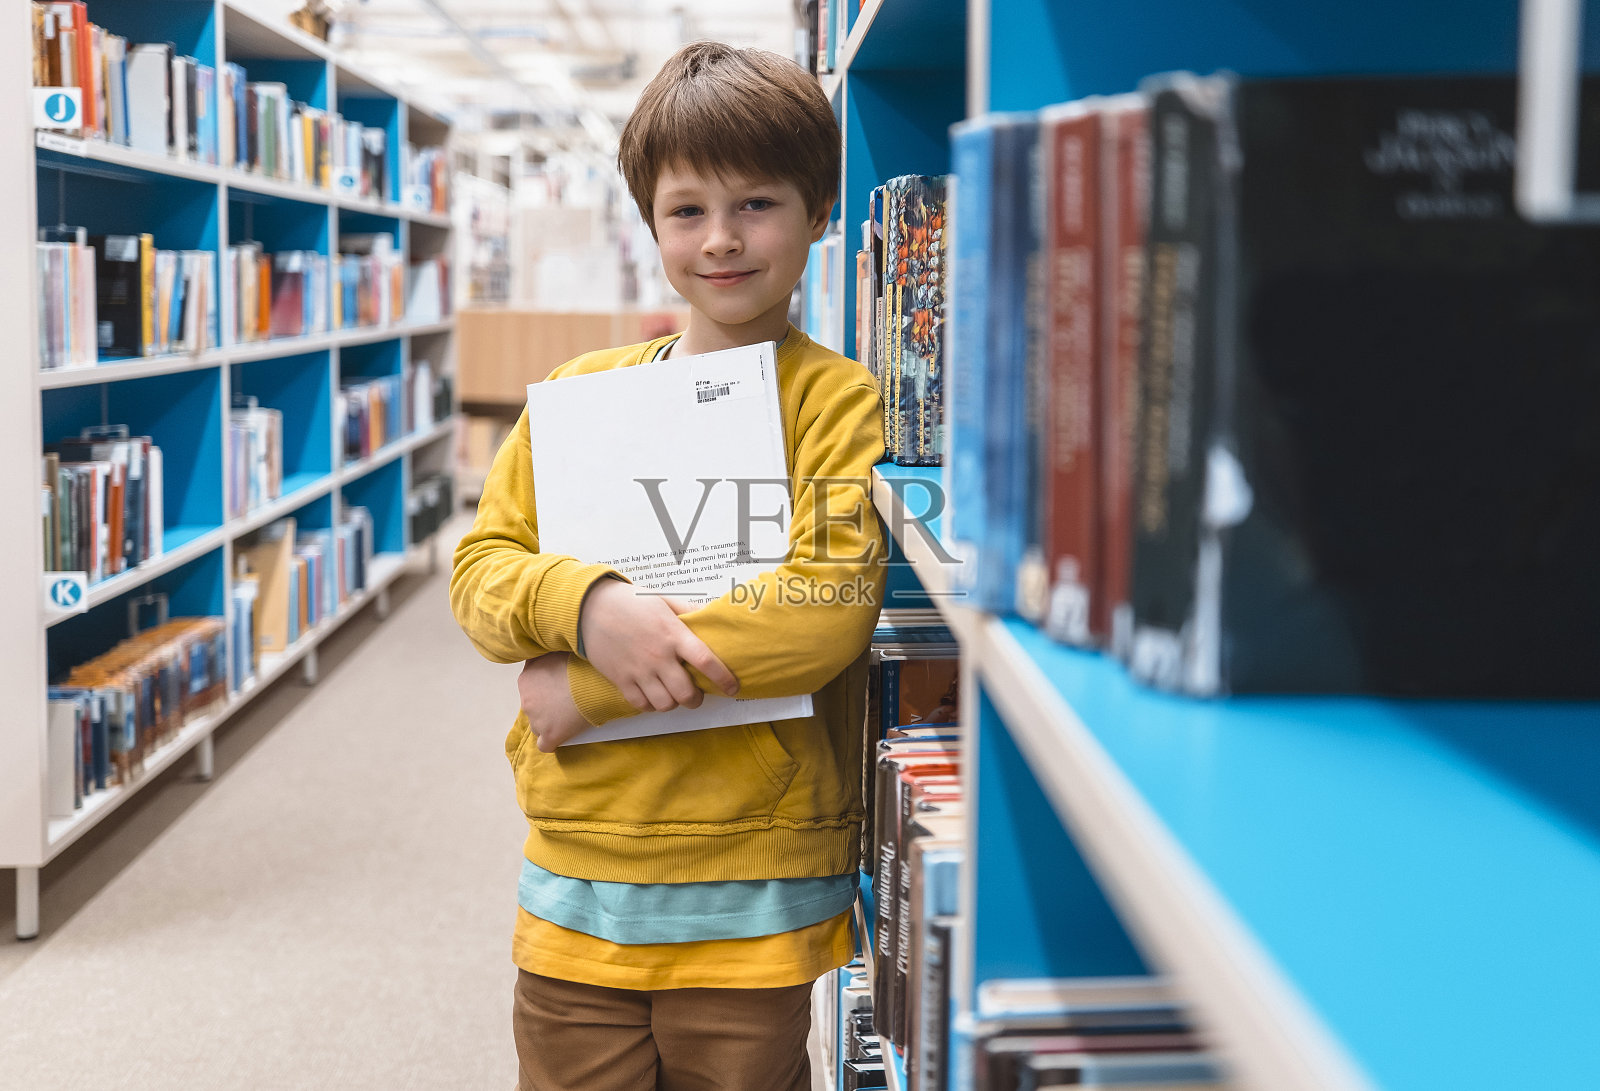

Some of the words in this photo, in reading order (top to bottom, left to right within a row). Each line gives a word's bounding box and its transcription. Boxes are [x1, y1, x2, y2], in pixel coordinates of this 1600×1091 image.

[52, 94, 66, 121] J
[631, 554, 641, 562] kaj
[642, 552, 656, 561] lepo
[656, 550, 669, 558] ime
[701, 544, 709, 552] To
[683, 558, 691, 566] pa
[692, 554, 716, 564] pomeni
[717, 552, 728, 560] biti
[666, 568, 691, 579] pretkan
[57, 581, 76, 604] K
